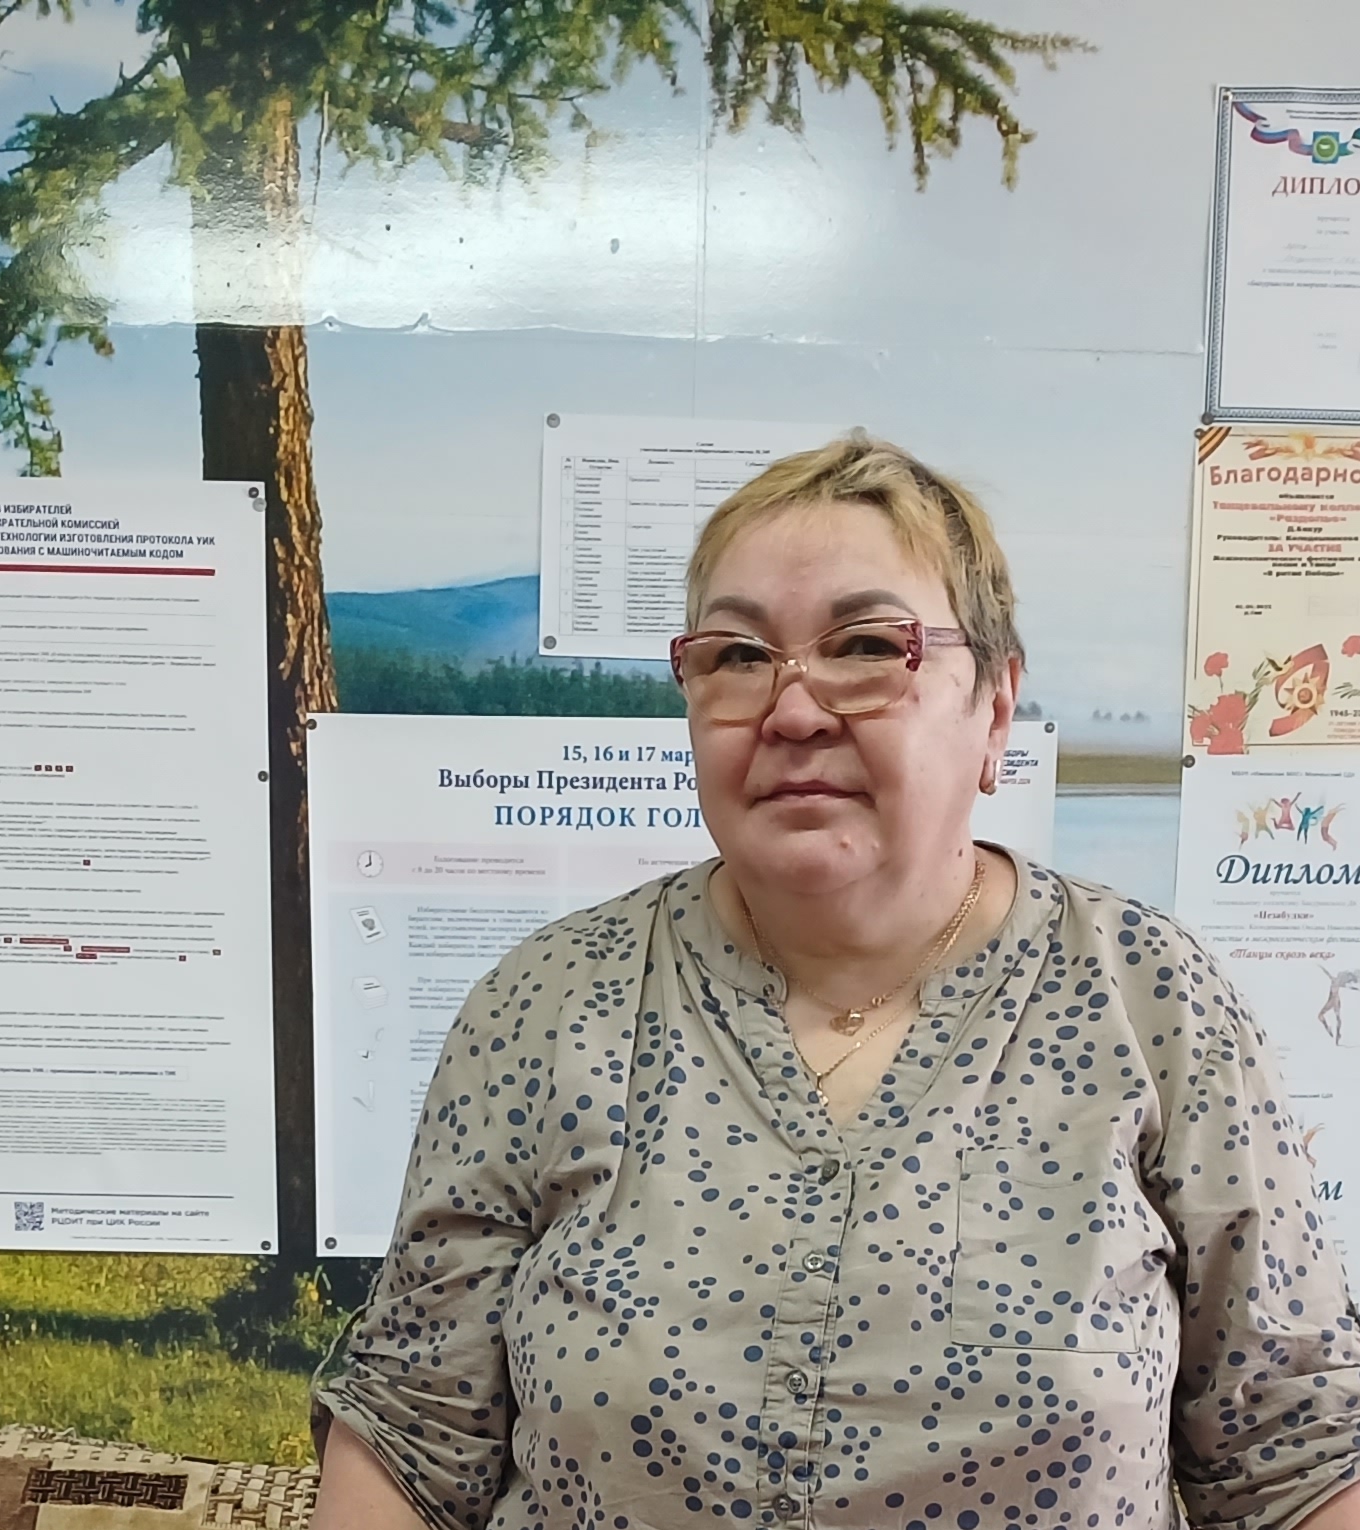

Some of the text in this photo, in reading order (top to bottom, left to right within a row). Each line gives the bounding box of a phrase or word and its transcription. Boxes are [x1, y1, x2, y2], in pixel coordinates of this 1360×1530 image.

[4, 503, 72, 515] ИЗБИРАТЕЛЕЙ
[61, 518, 120, 530] КОМИССИЕЙ
[59, 533, 134, 544] ИЗГОТОВЛЕНИЯ
[136, 535, 194, 545] ПРОТОКОЛА
[196, 536, 215, 546] УИК
[47, 547, 146, 558] МАШИНОЧИТАЕМЫМ
[149, 549, 184, 560] КОДОМ
[562, 745, 694, 767] 15, 16 и 17 мар
[438, 768, 668, 795] Выборы Президента
[495, 805, 636, 831] ПОРЯДОК
[51, 1207, 116, 1217] Методические
[119, 1209, 169, 1218] материалы
[105, 1218, 125, 1228] ЦИК
